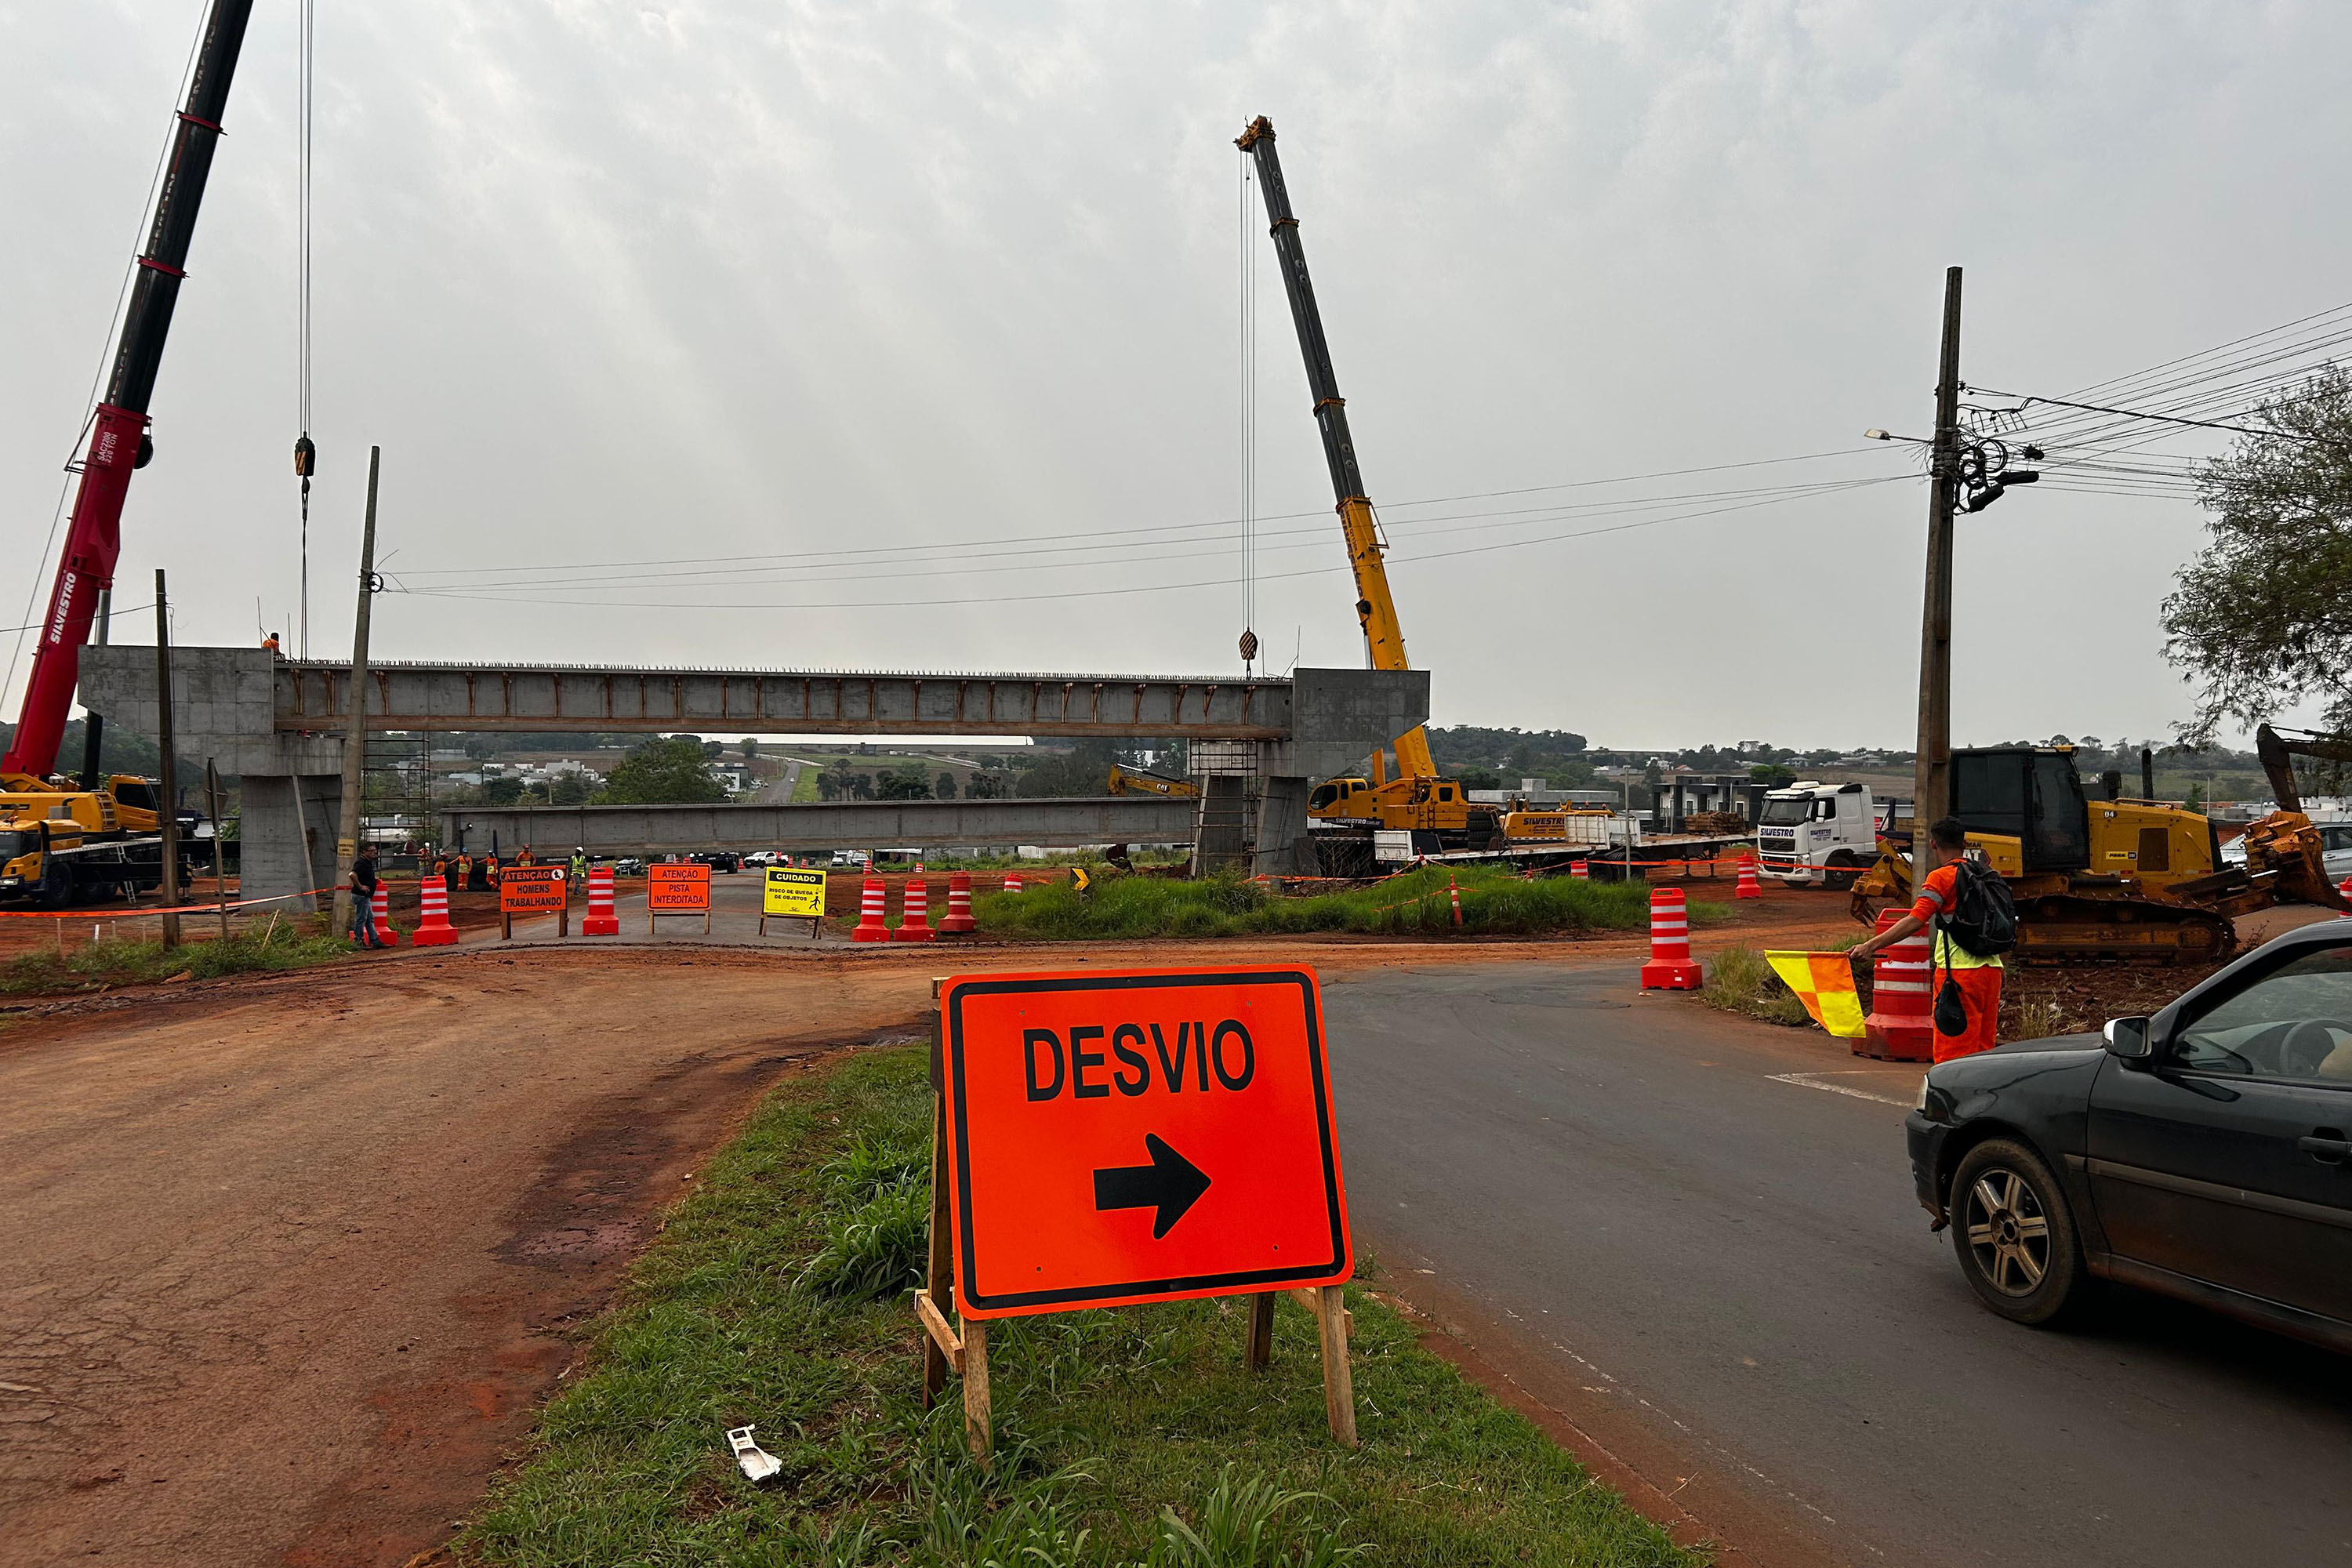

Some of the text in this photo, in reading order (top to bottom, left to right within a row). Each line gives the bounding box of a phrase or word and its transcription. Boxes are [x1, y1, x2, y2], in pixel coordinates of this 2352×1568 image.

[97, 432, 111, 461] SAC2200
[108, 434, 118, 448] TON
[50, 572, 76, 644] SILVESTRO
[1760, 828, 1794, 837] SILVESTRO
[504, 870, 550, 880] ATENÇÃO
[662, 868, 699, 880] ATENÇÃO
[776, 873, 816, 883] CUIDADO
[517, 884, 550, 895] HOMENS
[505, 897, 562, 907] TRABALHANDO
[654, 895, 704, 904] INTERDITADA
[1023, 1019, 1254, 1102] DESVIO
